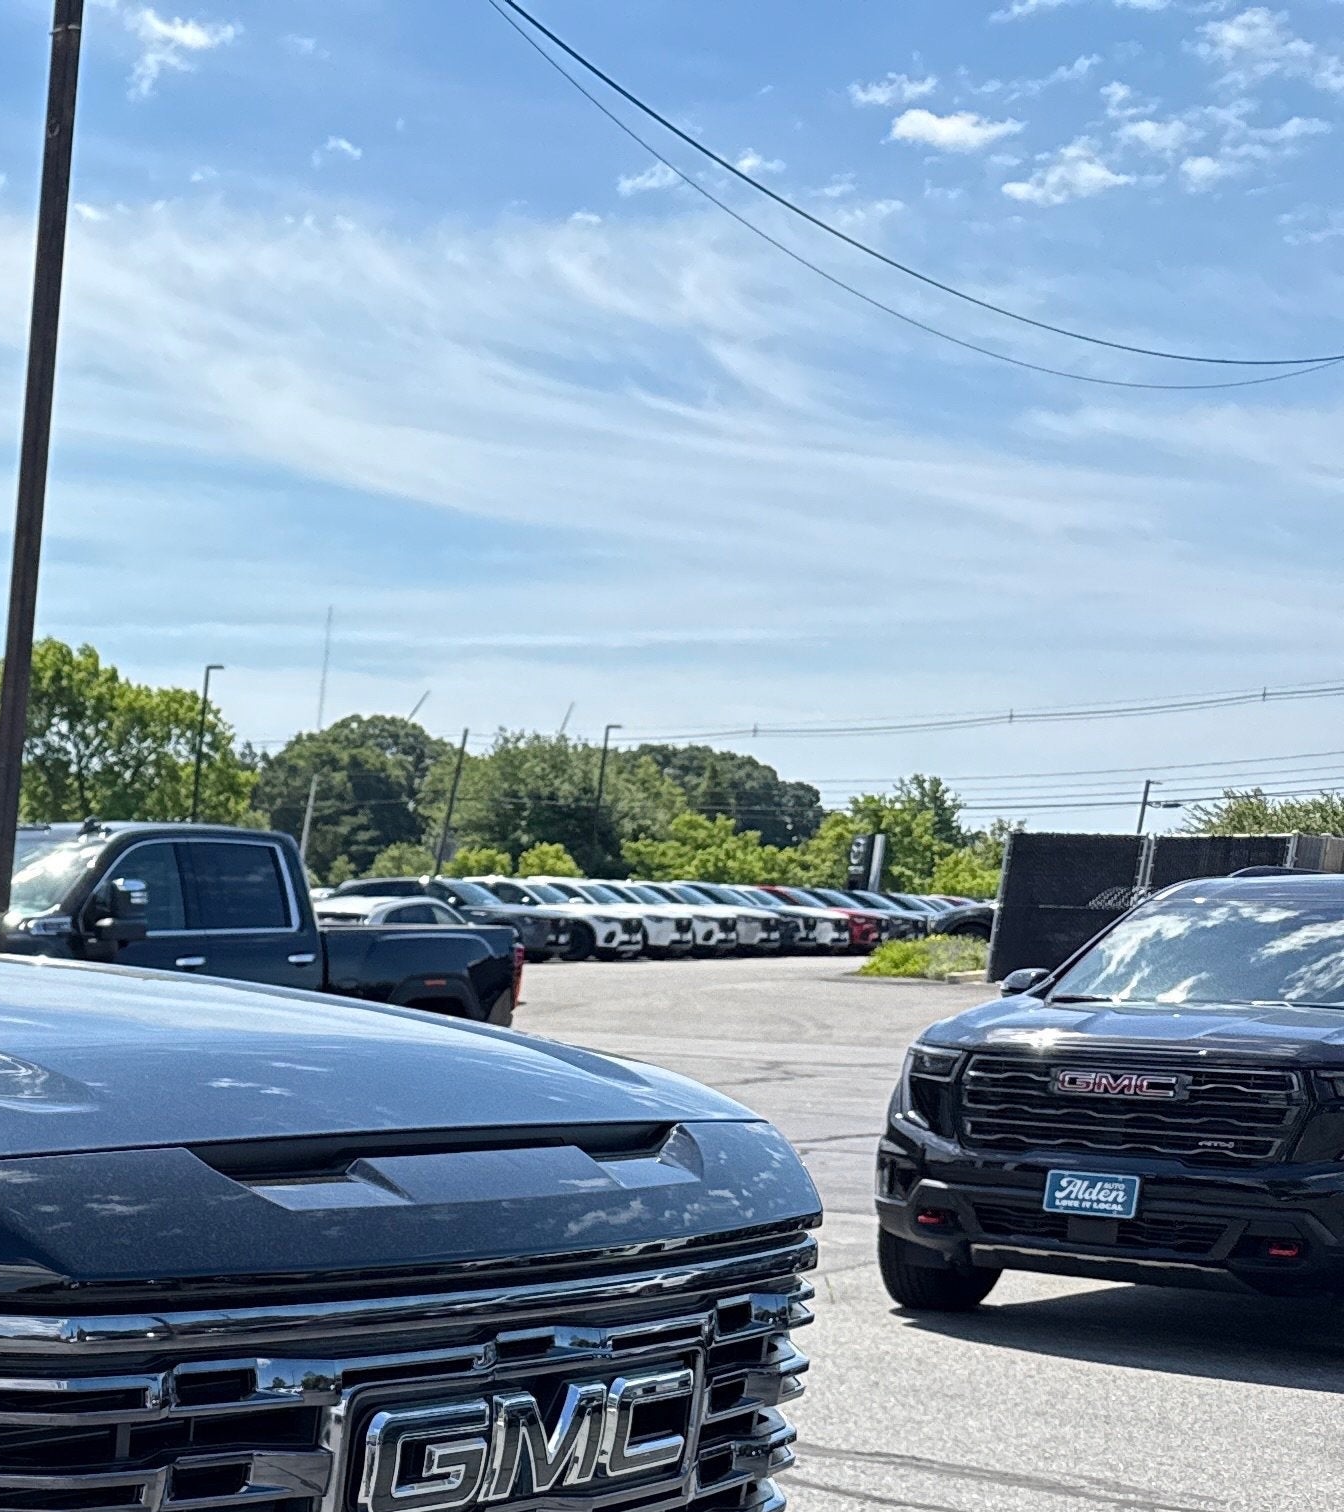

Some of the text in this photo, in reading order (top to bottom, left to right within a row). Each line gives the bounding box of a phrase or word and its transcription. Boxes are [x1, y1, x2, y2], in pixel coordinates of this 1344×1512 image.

[1058, 1071, 1177, 1097] GMC
[1055, 1177, 1128, 1203] Alden
[1103, 1182, 1126, 1191] AUTO
[1055, 1199, 1124, 1211] LOVE IT LOCAL
